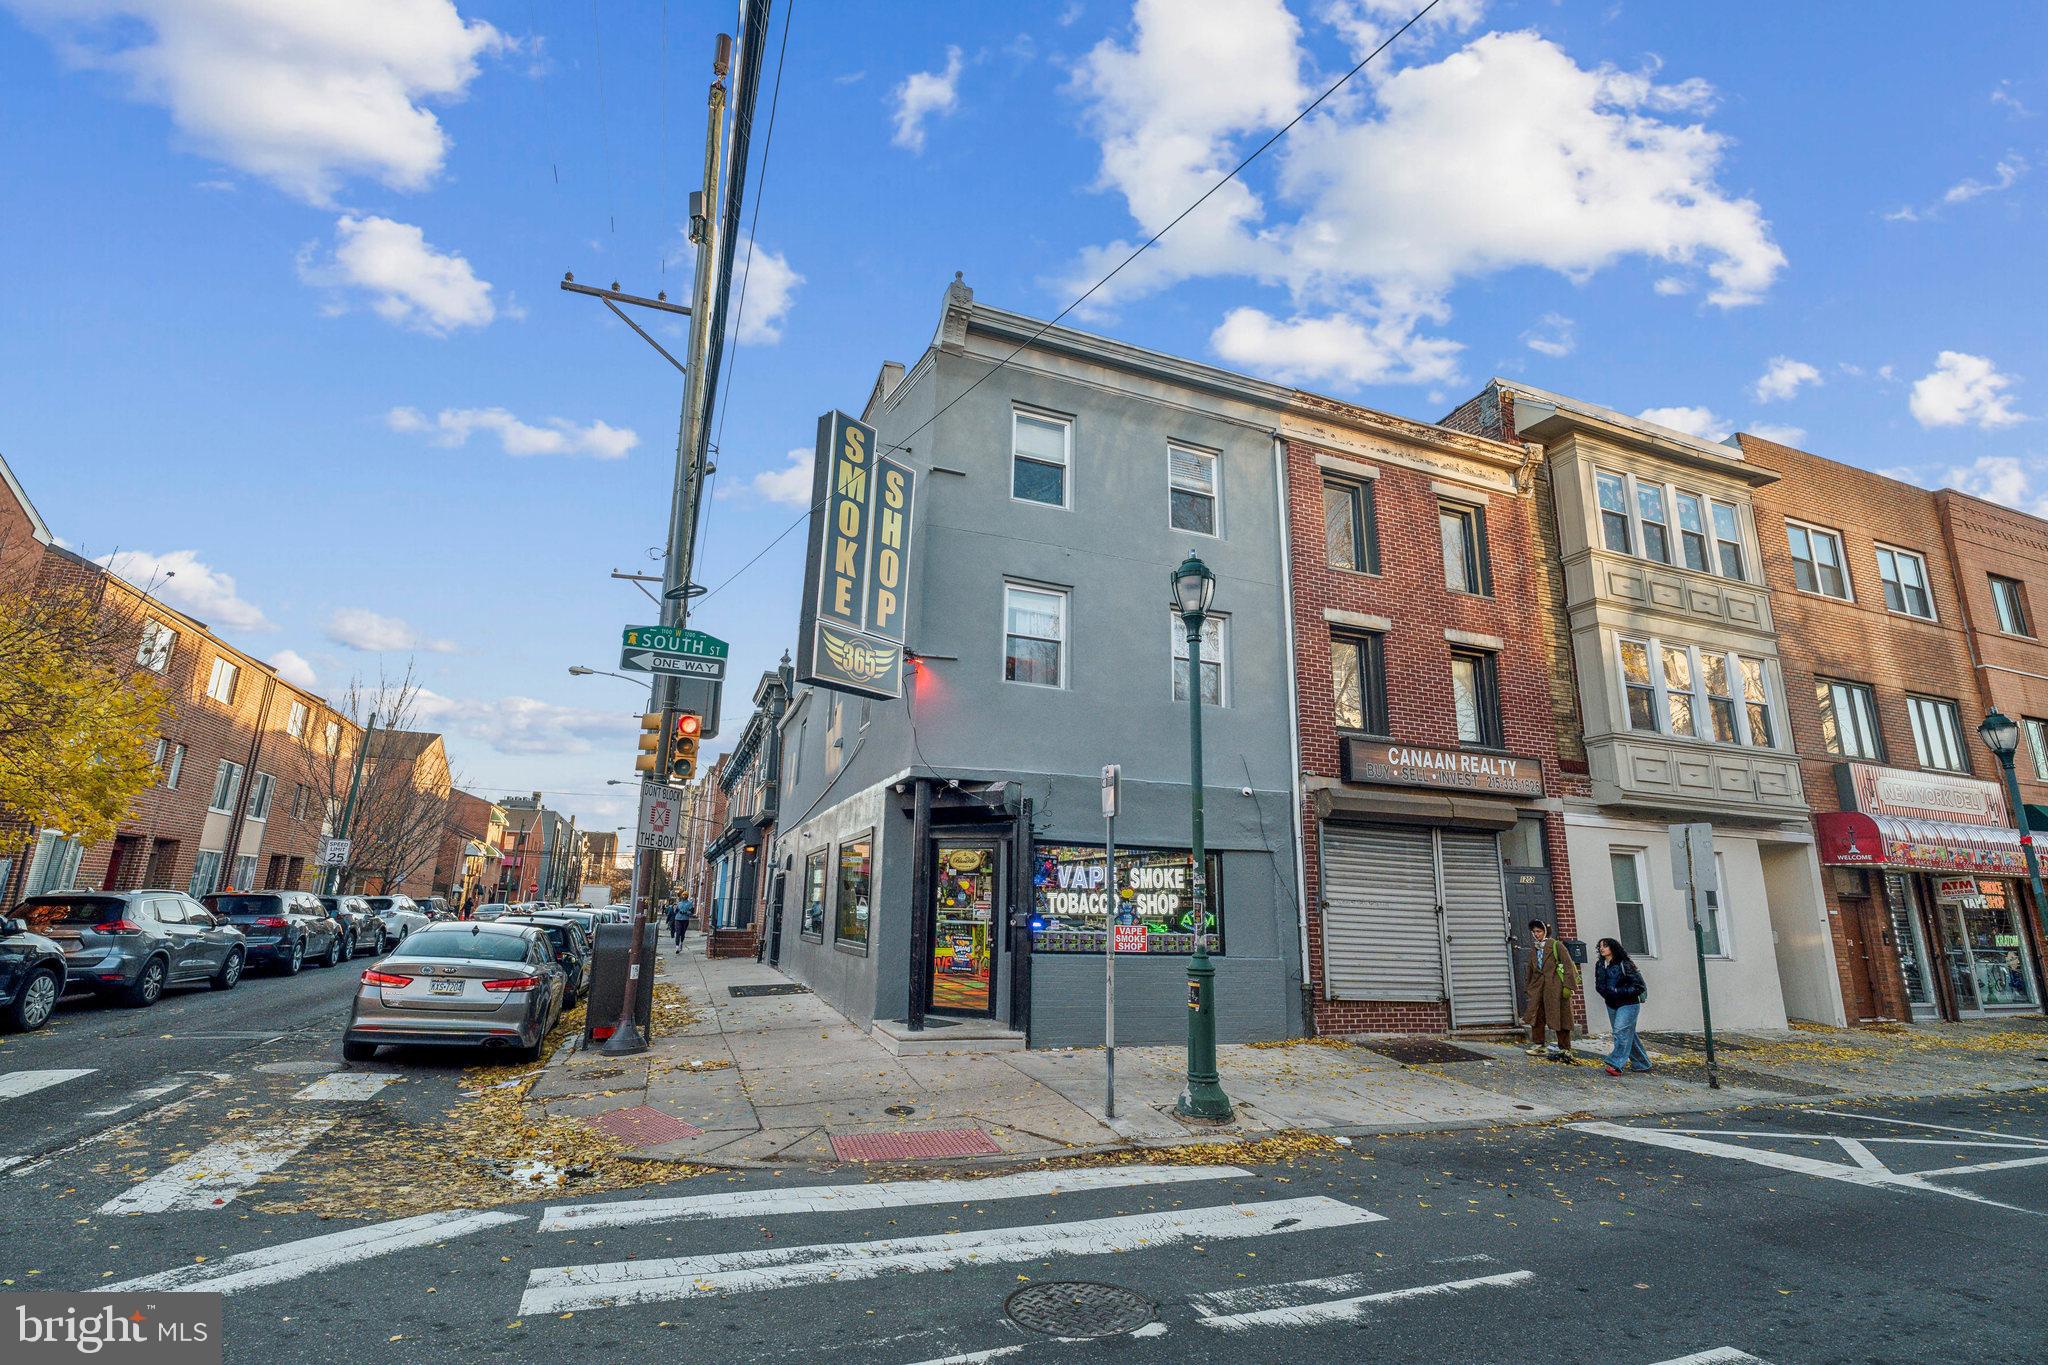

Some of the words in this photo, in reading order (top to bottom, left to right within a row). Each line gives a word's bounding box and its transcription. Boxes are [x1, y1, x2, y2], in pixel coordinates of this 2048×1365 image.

[834, 426, 866, 616] SMOKE
[876, 470, 904, 628] SHOP
[675, 629, 682, 637] W
[641, 633, 704, 654] SOUTH
[710, 645, 721, 656] ST
[652, 657, 680, 669] ONE
[684, 661, 715, 673] WAY
[841, 642, 877, 676] 365
[1388, 747, 1456, 771] CANAAN
[1460, 755, 1517, 777] REALTY
[1366, 762, 1390, 779] BUY
[1401, 766, 1429, 782] SELL
[1438, 770, 1478, 787] INVEST
[662, 788, 680, 801] BLOCK
[1882, 782, 1916, 802] NEW
[1916, 786, 1954, 807] YORK
[1953, 790, 1982, 810] DELI
[640, 832, 655, 847] THE
[657, 835, 675, 849] BOX
[327, 852, 344, 863] 25
[1057, 866, 1117, 889] VAPE
[1130, 868, 1184, 889] SMOKE
[1941, 880, 1974, 890] ATM
[1136, 893, 1179, 914] SHOP
[1181, 914, 1215, 925] AM
[1115, 934, 1146, 943] SMOKE
[1119, 927, 1143, 935] VAPE
[1118, 942, 1143, 950] SHOP
